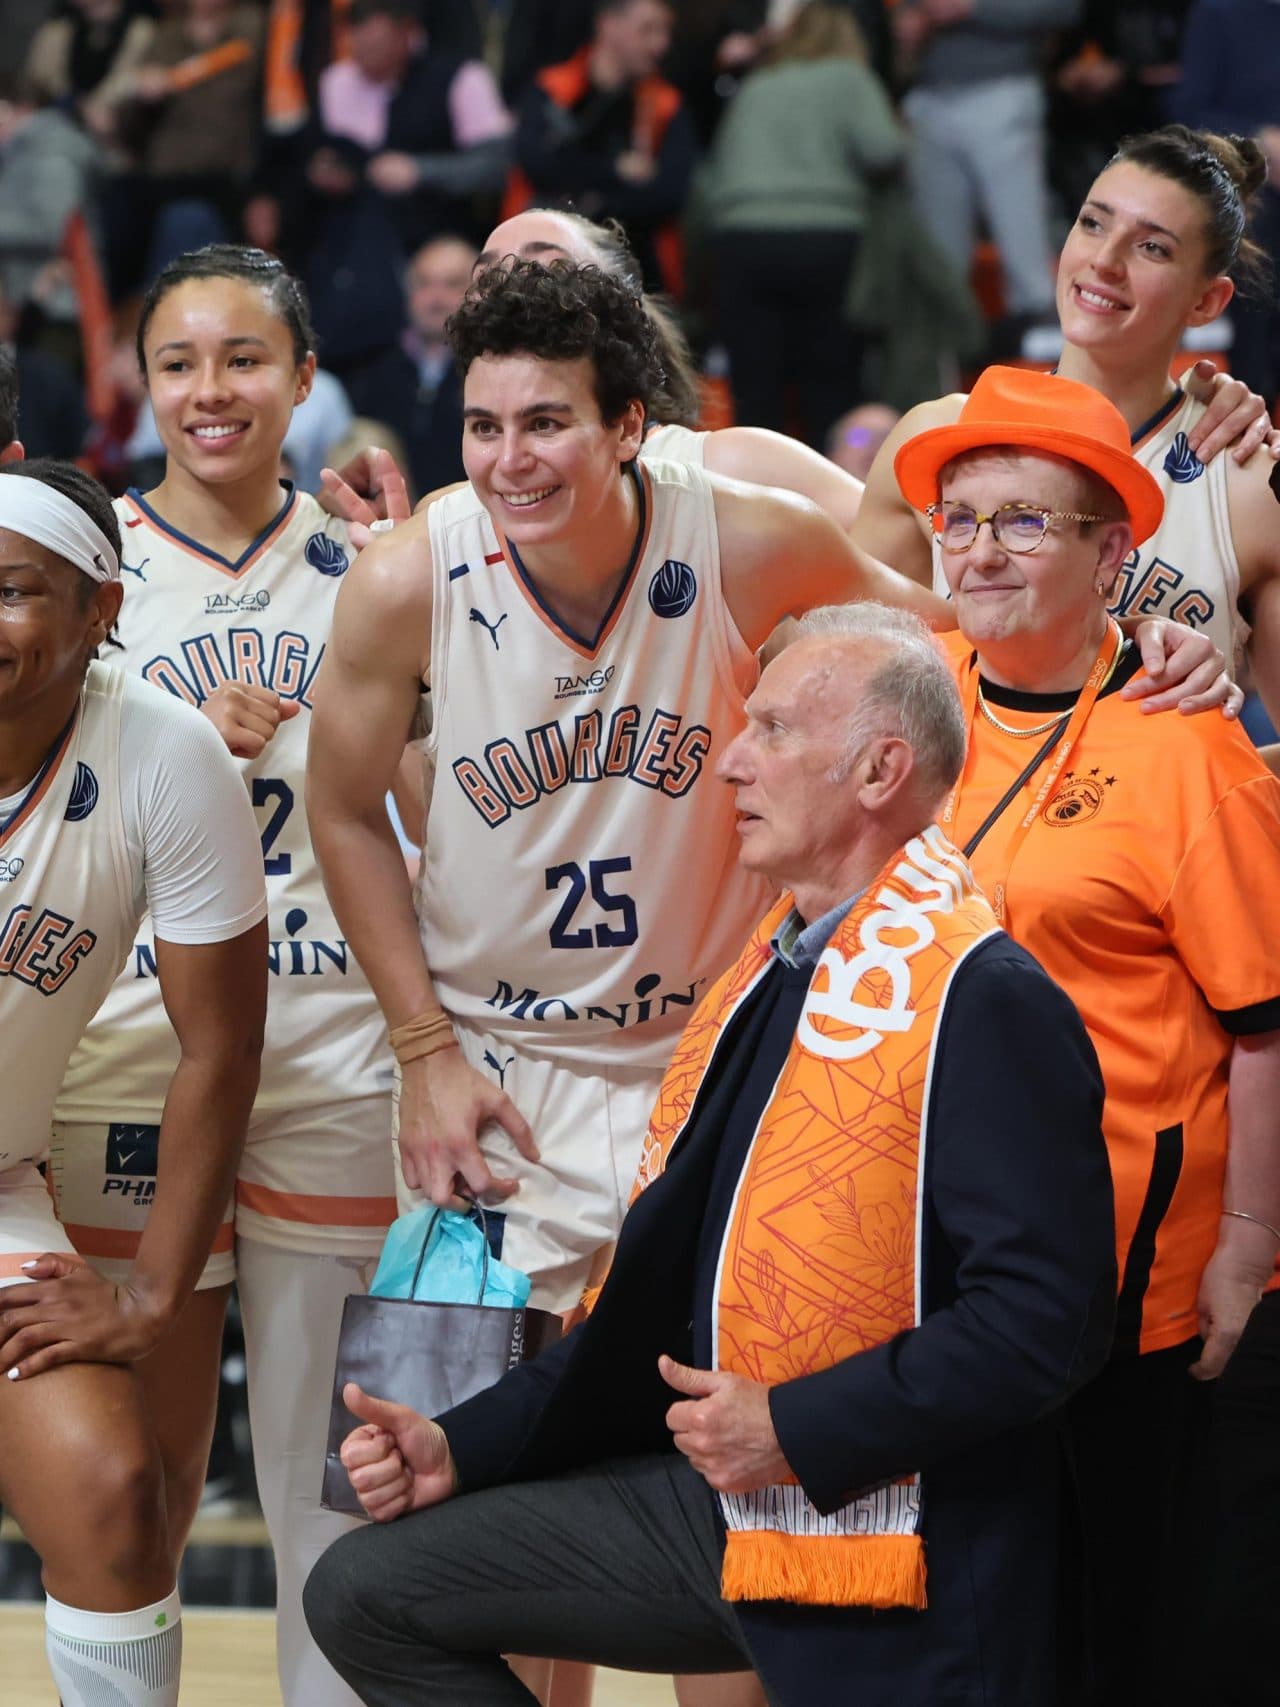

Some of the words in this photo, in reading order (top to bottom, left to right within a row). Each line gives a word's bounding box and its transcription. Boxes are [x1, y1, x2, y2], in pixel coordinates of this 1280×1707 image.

[204, 590, 270, 608] TANGO
[142, 628, 326, 710] OURG
[554, 665, 615, 692] TANGO
[452, 705, 711, 829] BOURGES
[545, 856, 639, 949] 25
